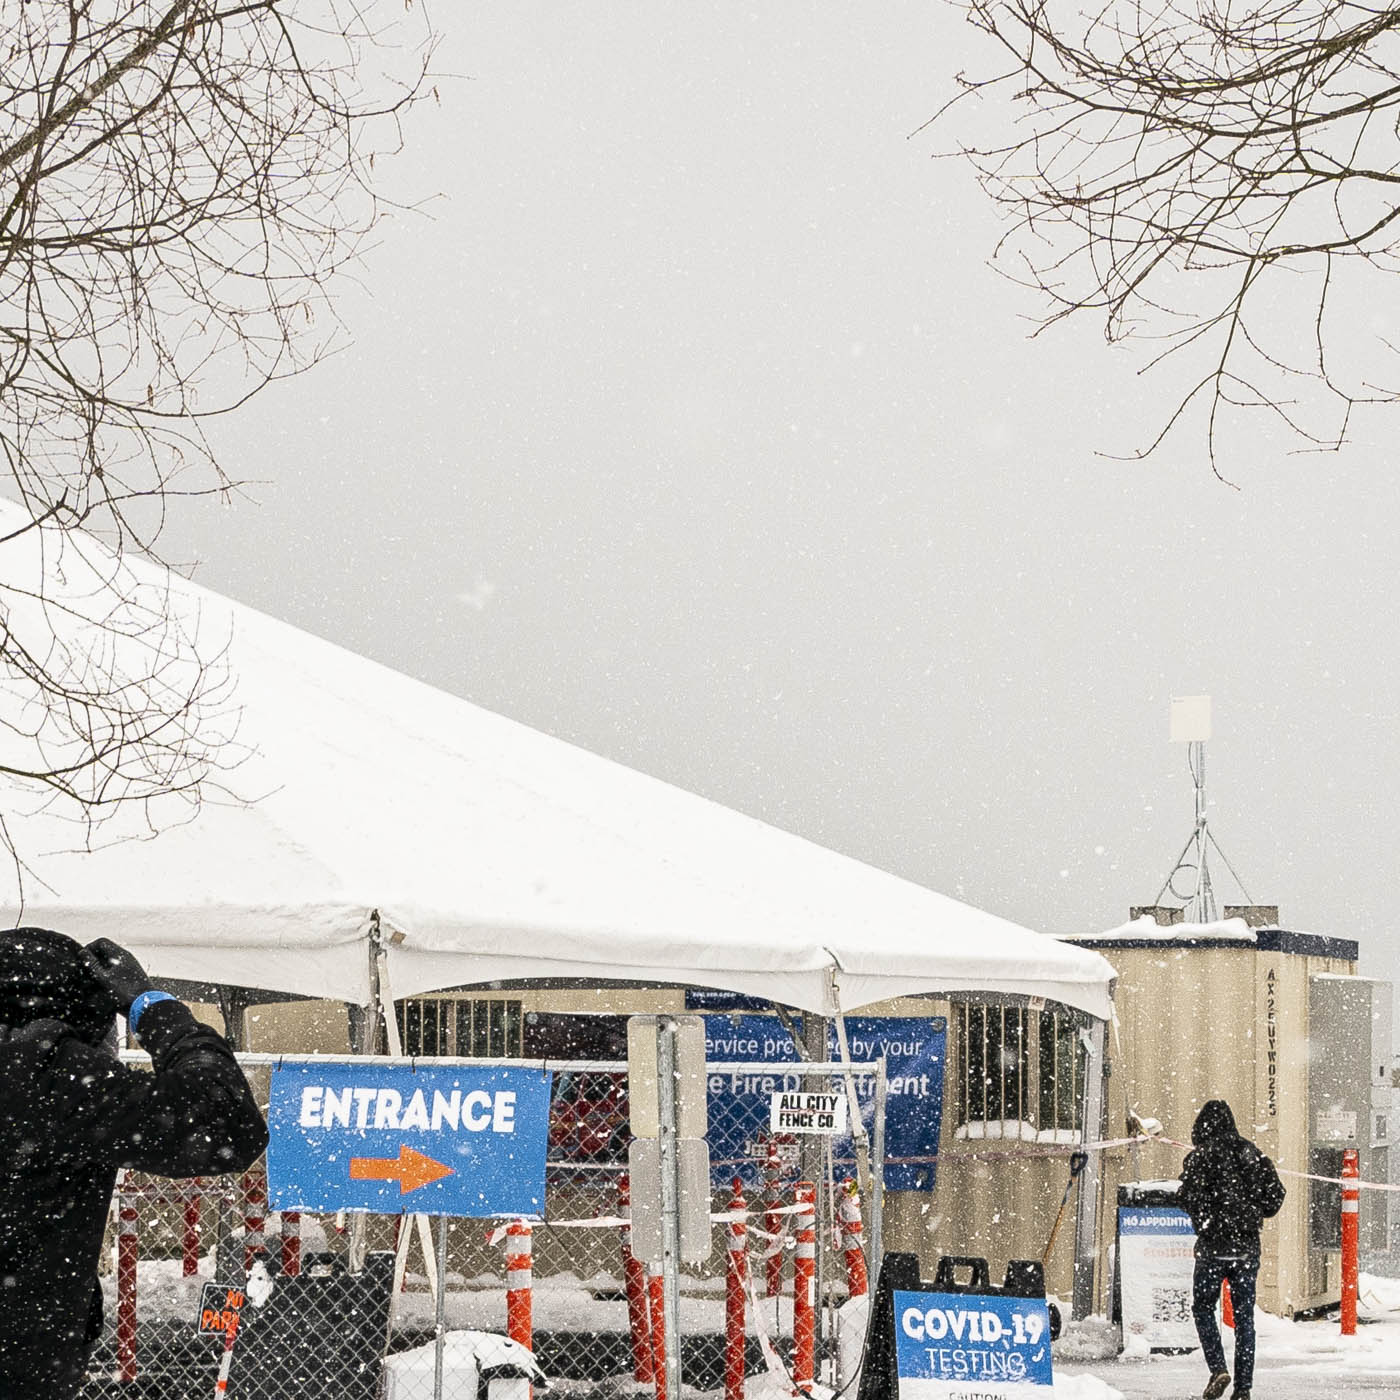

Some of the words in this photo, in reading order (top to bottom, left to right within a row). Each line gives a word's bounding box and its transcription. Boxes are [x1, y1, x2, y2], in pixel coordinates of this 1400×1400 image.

[704, 1037, 758, 1055] ervice
[764, 1036, 843, 1060] proed
[852, 1036, 875, 1060] by
[881, 1038, 924, 1059] your
[731, 1072, 776, 1095] Fire
[783, 1072, 931, 1096] Datent
[299, 1086, 517, 1133] ENTRANCE
[780, 1094, 801, 1109] ALL
[806, 1095, 839, 1111] CITY
[779, 1112, 814, 1128] FENCE
[818, 1114, 838, 1128] CO.
[1123, 1216, 1138, 1227] NO
[902, 1308, 1044, 1345] COVID-19
[925, 1348, 1027, 1375] TESTING
